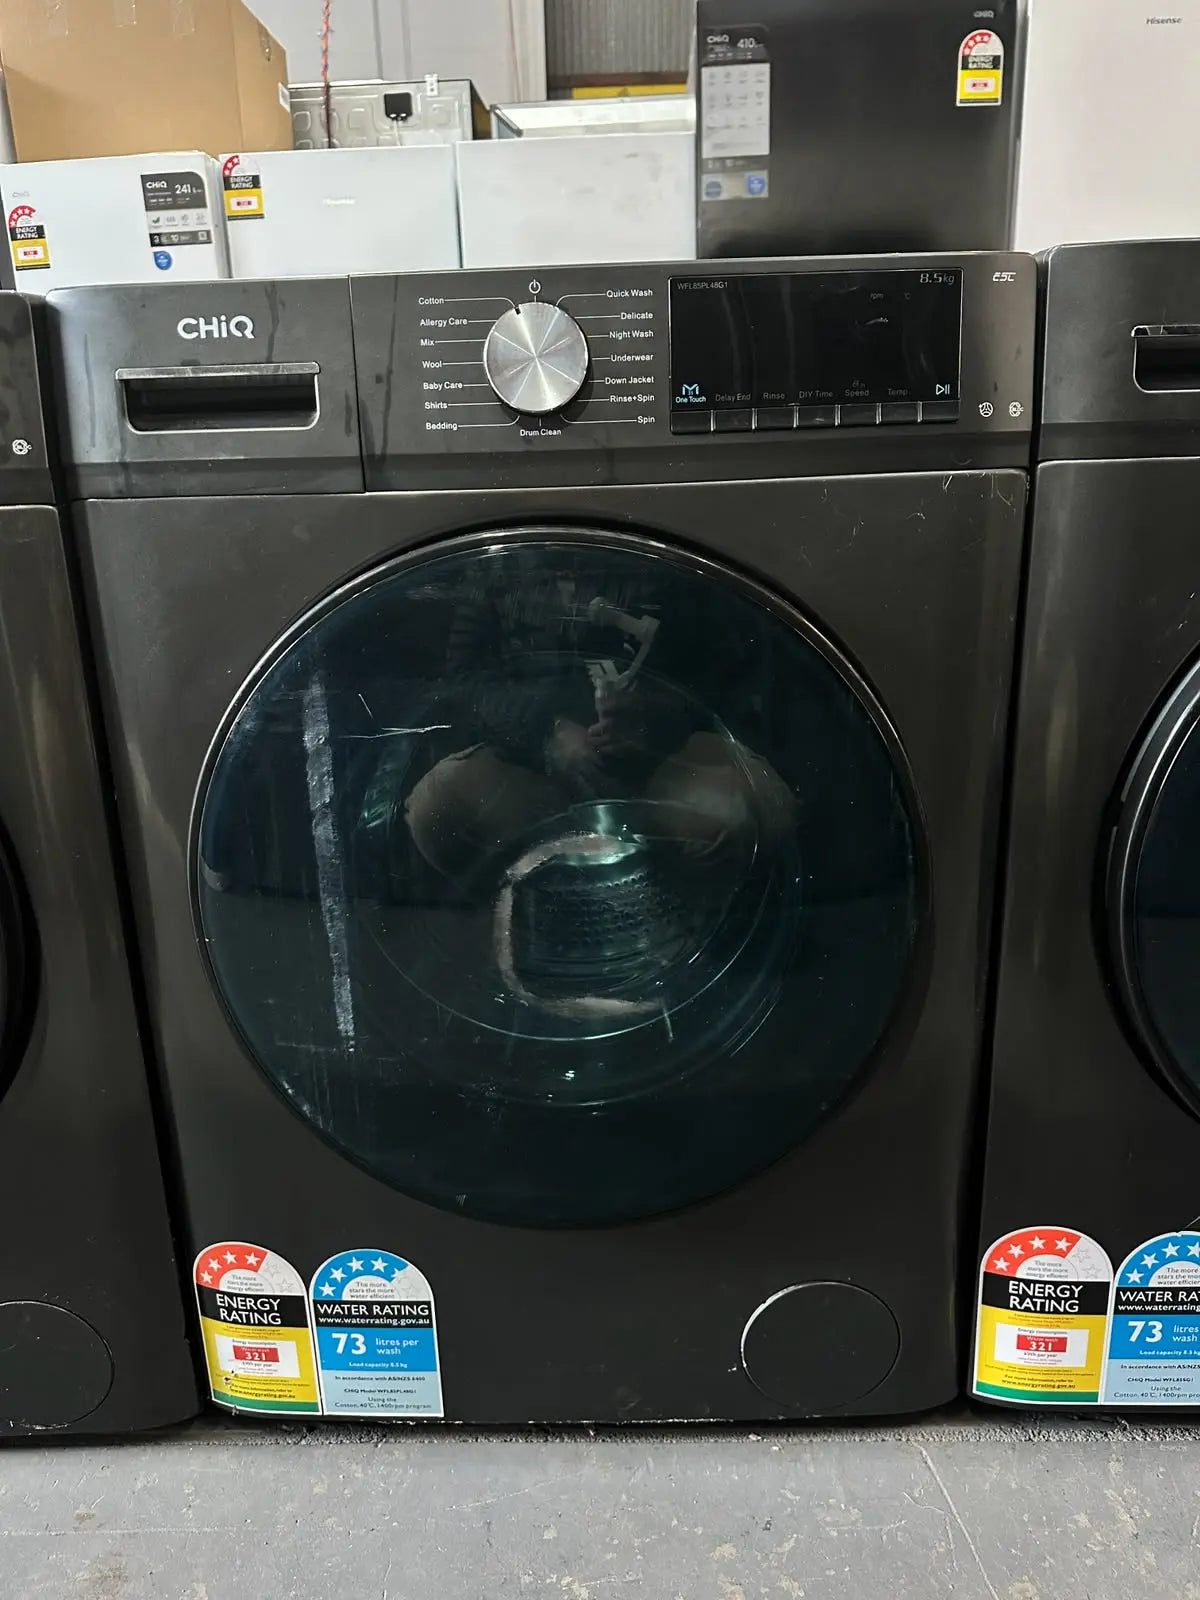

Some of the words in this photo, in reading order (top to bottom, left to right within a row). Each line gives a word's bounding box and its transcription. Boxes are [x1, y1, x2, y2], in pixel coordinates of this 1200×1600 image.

[1145, 16, 1184, 25] Hisense
[737, 37, 756, 49] 410
[146, 181, 167, 190] CHiQ
[174, 183, 192, 194] 241
[606, 289, 630, 298] Quick
[630, 288, 654, 297] Wash
[418, 297, 445, 305] Cotton
[620, 311, 654, 320] Delicate
[177, 314, 255, 340] CHiQ
[420, 318, 448, 328] Allergy
[448, 317, 468, 326] Care
[609, 330, 631, 341] Night
[631, 329, 654, 338] Wash
[420, 338, 435, 346] Mix
[610, 354, 655, 362] Underwear
[422, 360, 443, 369] Wool
[604, 376, 627, 385] Down
[628, 375, 655, 384] Jacket
[423, 382, 443, 392] Baby
[443, 381, 463, 389] Care
[715, 393, 736, 402] Delay
[736, 392, 751, 401] End
[763, 391, 786, 400] Rinse
[799, 390, 813, 399] DIY
[815, 389, 834, 398] Time
[844, 388, 870, 398] Speed
[609, 394, 655, 403] Rinse+Spin
[675, 396, 689, 404] One
[688, 394, 707, 403] Touch
[424, 401, 448, 410] Shirts
[637, 415, 656, 425] Spin
[425, 421, 458, 431] Bedding
[519, 429, 540, 437] Drum
[540, 428, 562, 436] Clean
[1008, 1280, 1084, 1298] ENERGY
[1119, 1290, 1173, 1303] WATER
[215, 1293, 281, 1311] ENERGY
[1009, 1295, 1080, 1313] RATING
[317, 1303, 369, 1315] WATER
[373, 1304, 430, 1315] RATING
[219, 1308, 282, 1324] RATING
[318, 1316, 430, 1326] www.waterrating.gov.au
[1017, 1327, 1035, 1335] Energy
[1127, 1320, 1164, 1343] 73
[1173, 1324, 1200, 1333] litres
[375, 1337, 402, 1346] litres
[403, 1338, 419, 1348] per
[1172, 1334, 1198, 1342] wash
[331, 1332, 368, 1356] 73
[1029, 1341, 1052, 1351] 321
[376, 1347, 401, 1355] wash
[245, 1352, 267, 1361] 321
[1113, 1391, 1140, 1399] Cotton,
